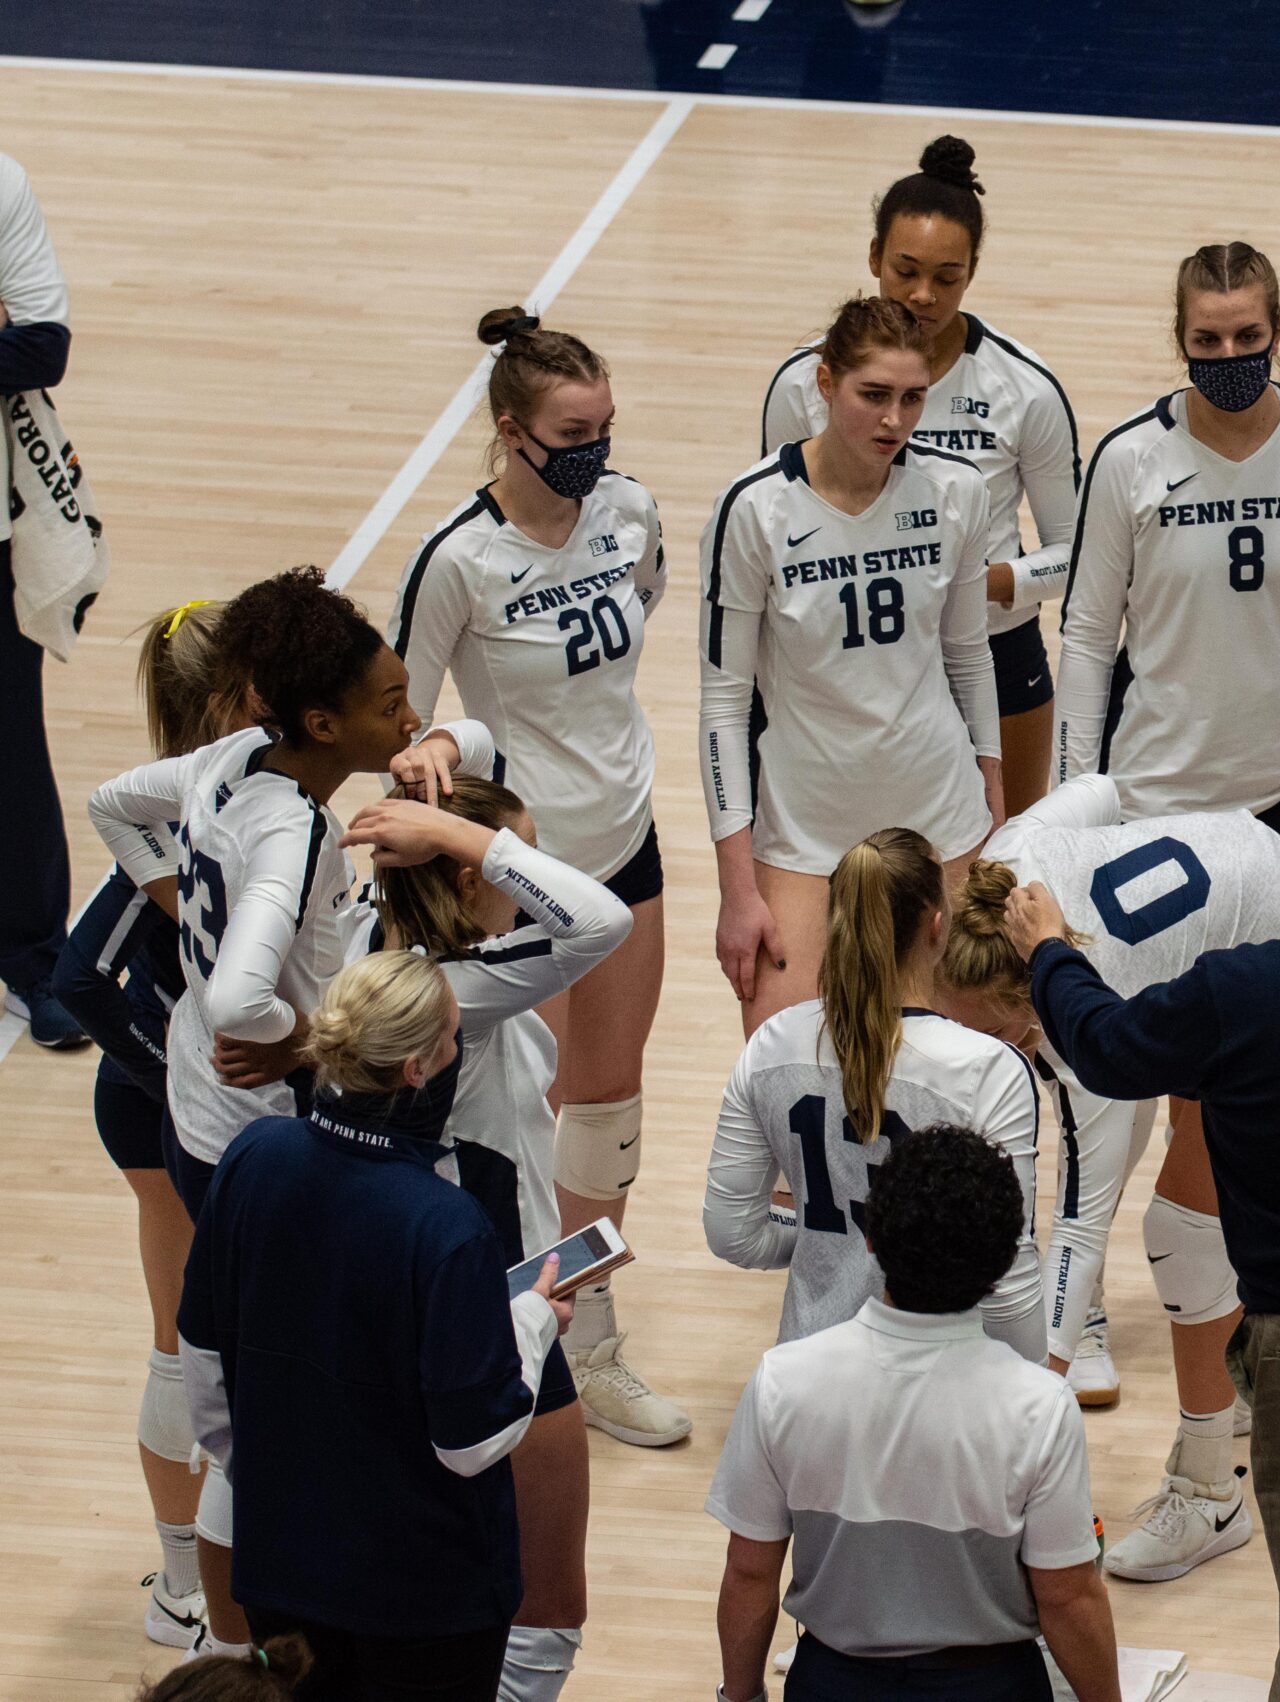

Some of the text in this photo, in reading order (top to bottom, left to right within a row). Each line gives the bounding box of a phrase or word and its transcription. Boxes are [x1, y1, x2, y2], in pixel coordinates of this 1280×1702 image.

[11, 393, 82, 524] GATORA
[1158, 499, 1235, 527] PENN
[782, 541, 942, 588] PENN STATE
[1228, 525, 1264, 592] 8
[505, 585, 572, 624] PENN
[558, 594, 631, 677] 20
[839, 576, 905, 650] 18
[1060, 720, 1068, 752] LIONS
[709, 731, 727, 811] NITTANY LIONS
[505, 867, 574, 927] NITTANY LIONS
[1090, 836, 1211, 946] 0
[320, 1116, 332, 1130] ARE
[333, 1123, 355, 1139] PENN
[1052, 1245, 1072, 1328] NITTANY LIONS
